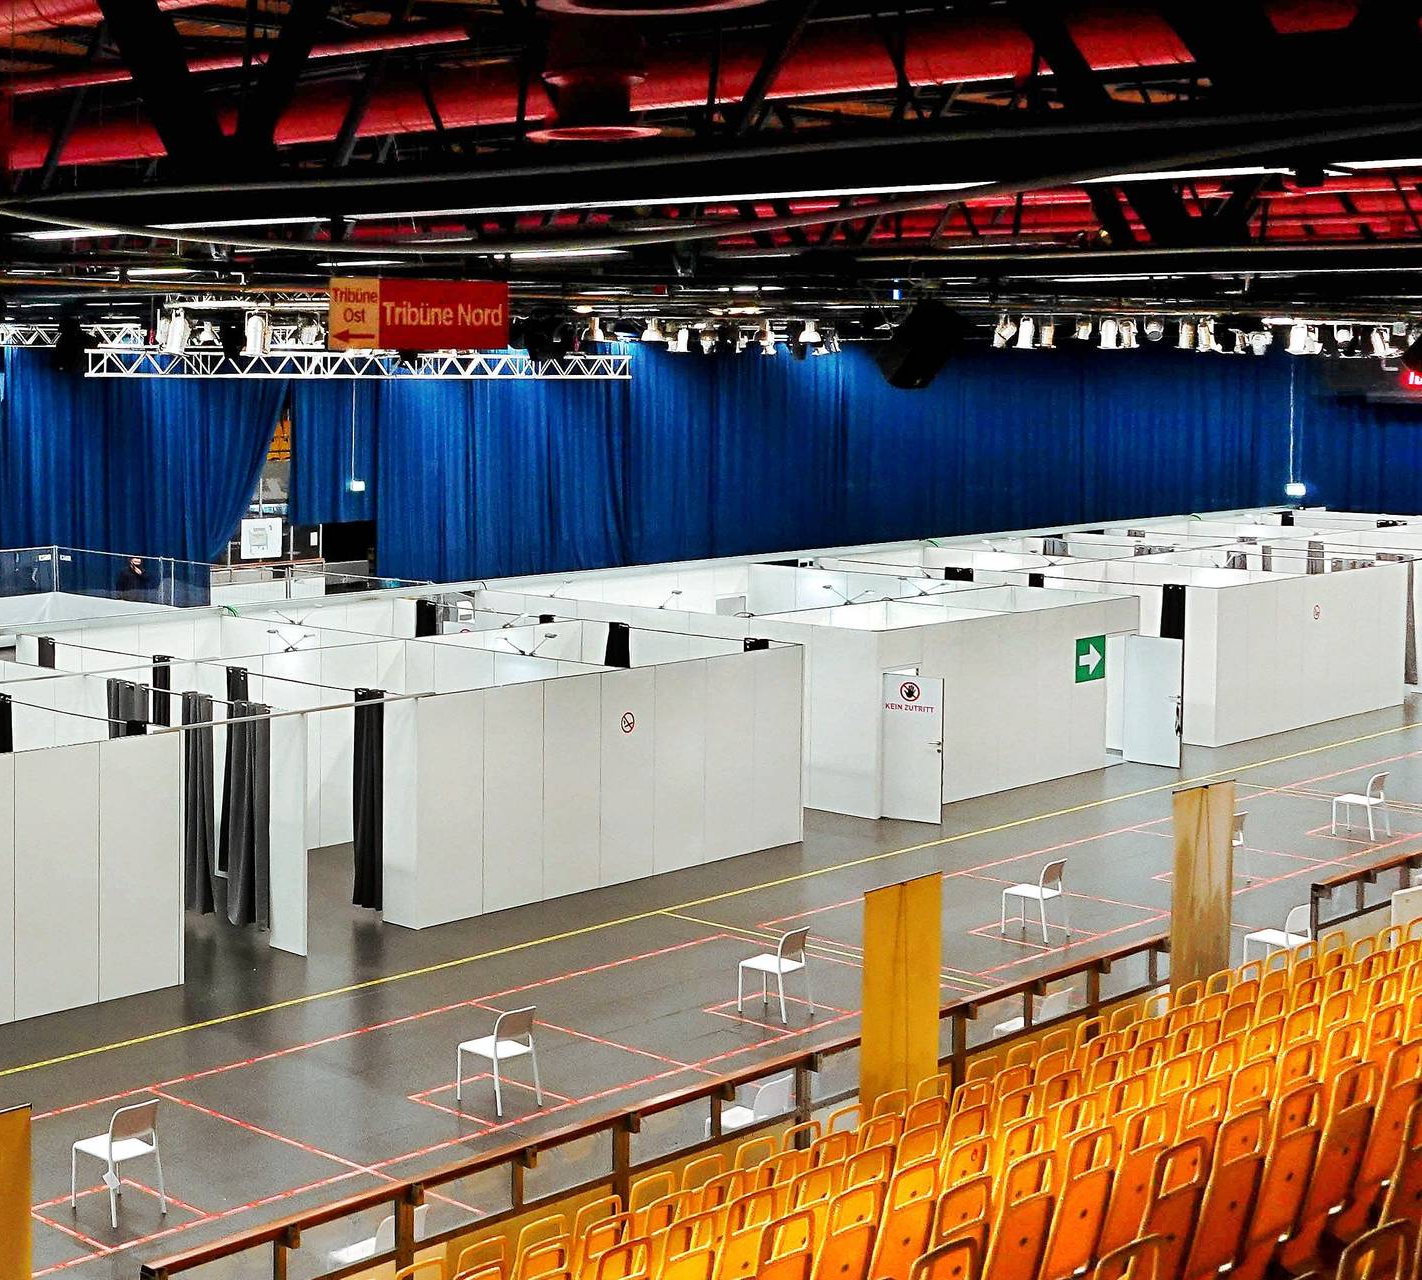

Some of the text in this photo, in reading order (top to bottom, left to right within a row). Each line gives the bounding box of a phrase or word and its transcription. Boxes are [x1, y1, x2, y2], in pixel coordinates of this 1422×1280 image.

[332, 287, 378, 303] Tribüne
[343, 307, 366, 324] Ost
[382, 301, 503, 327] Tribüne Nord
[885, 702, 935, 713] KEIN ZUTRITT
